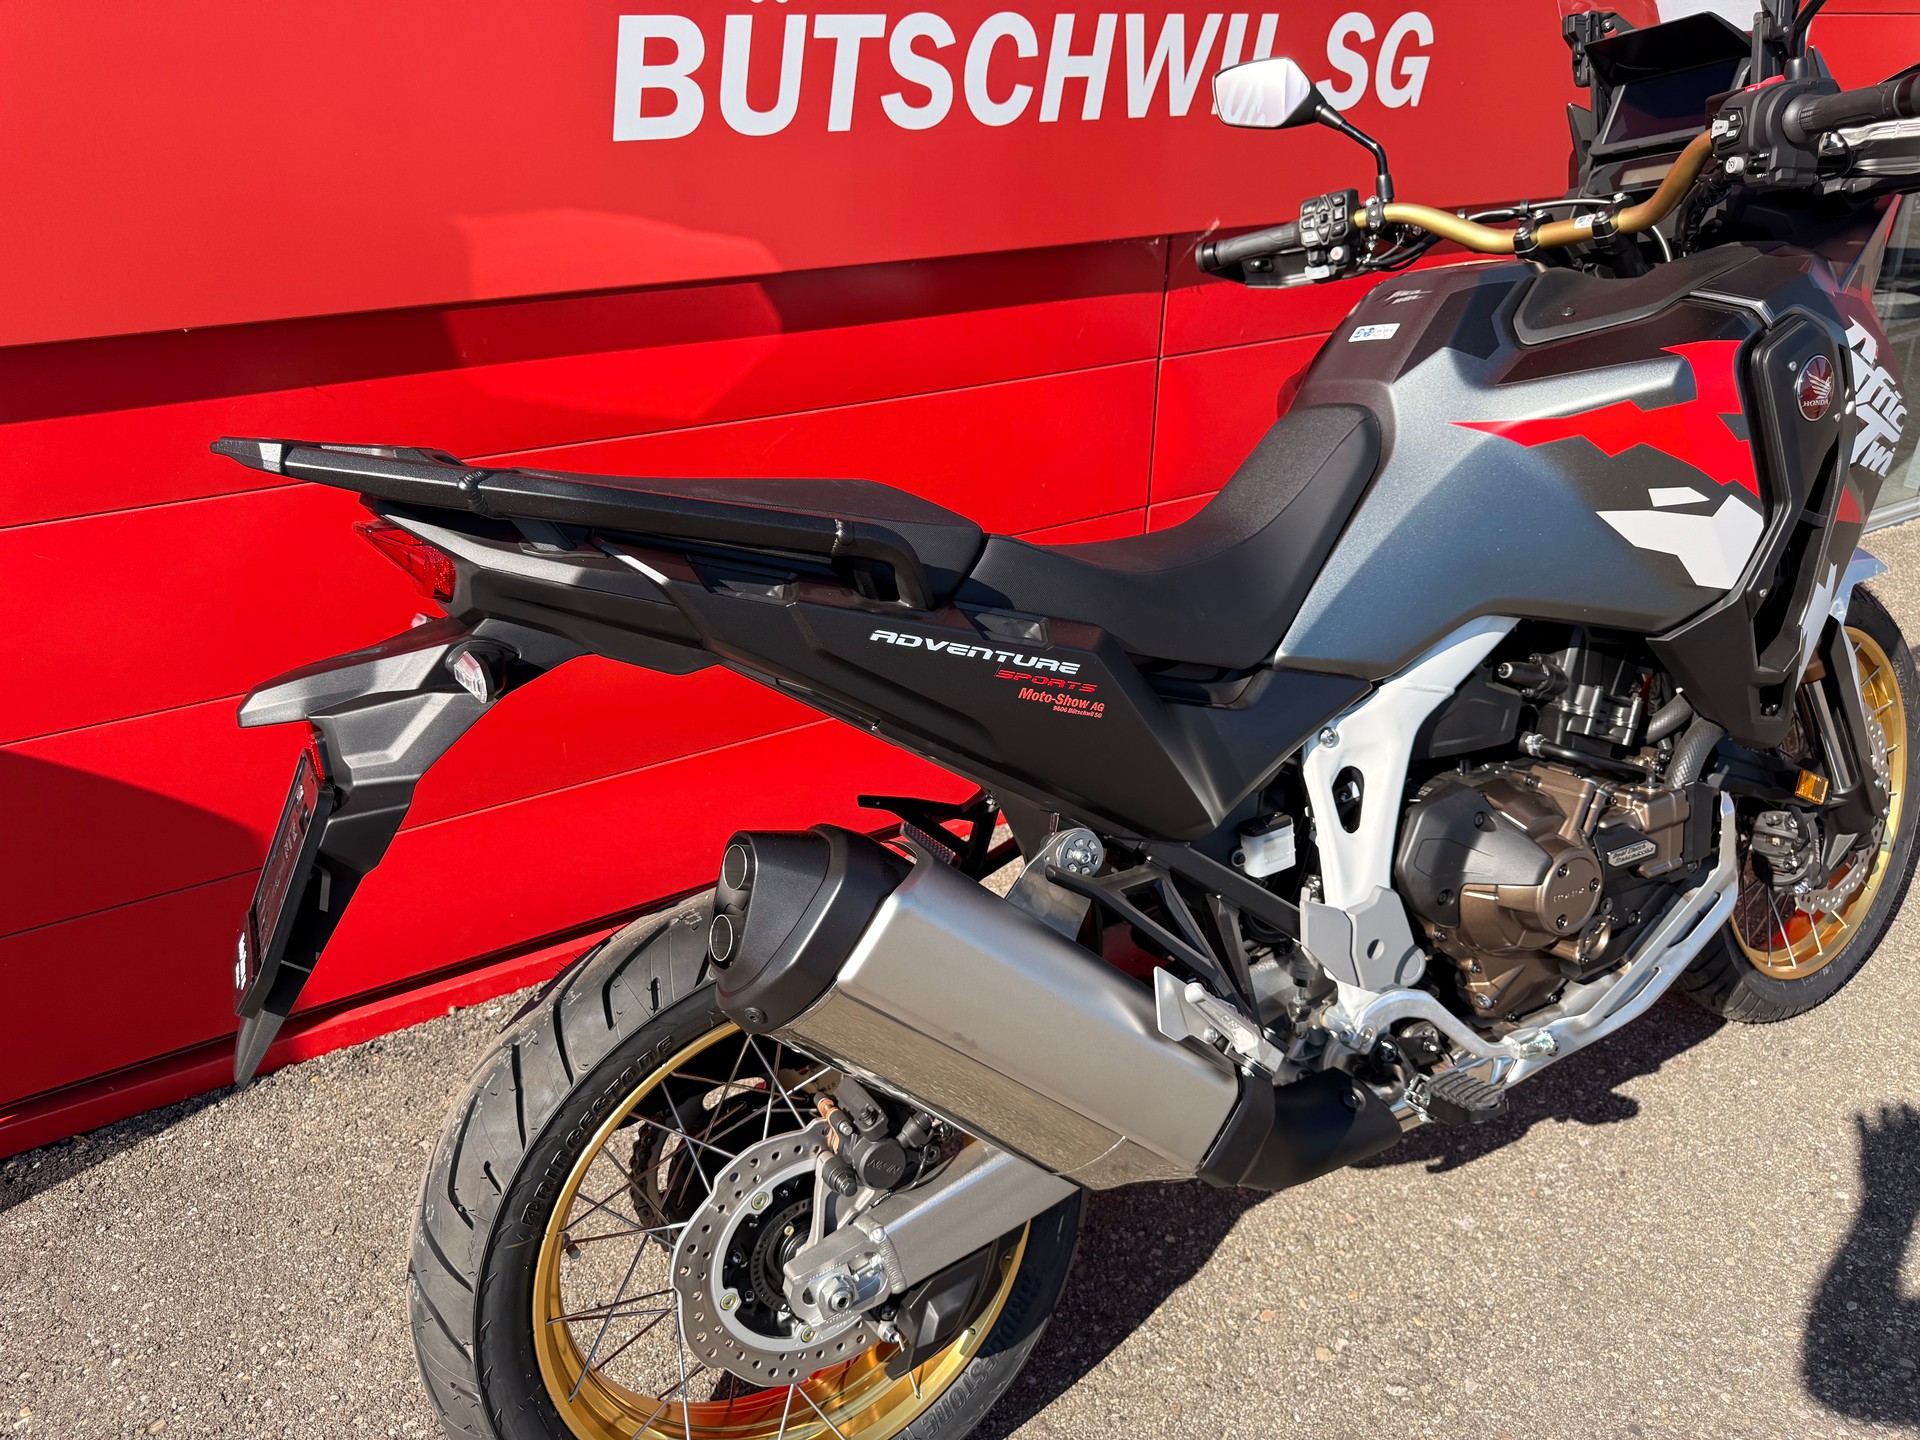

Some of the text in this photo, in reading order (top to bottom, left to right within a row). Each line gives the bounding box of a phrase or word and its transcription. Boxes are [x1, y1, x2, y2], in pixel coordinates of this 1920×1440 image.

[1314, 11, 1434, 111] SG
[1845, 315, 1908, 434] Afric
[1803, 399, 1829, 408] HONDA
[869, 629, 1081, 675] ADVENTURE
[995, 669, 1098, 693] SPORTS
[1018, 687, 1105, 712] Moto-Show AG
